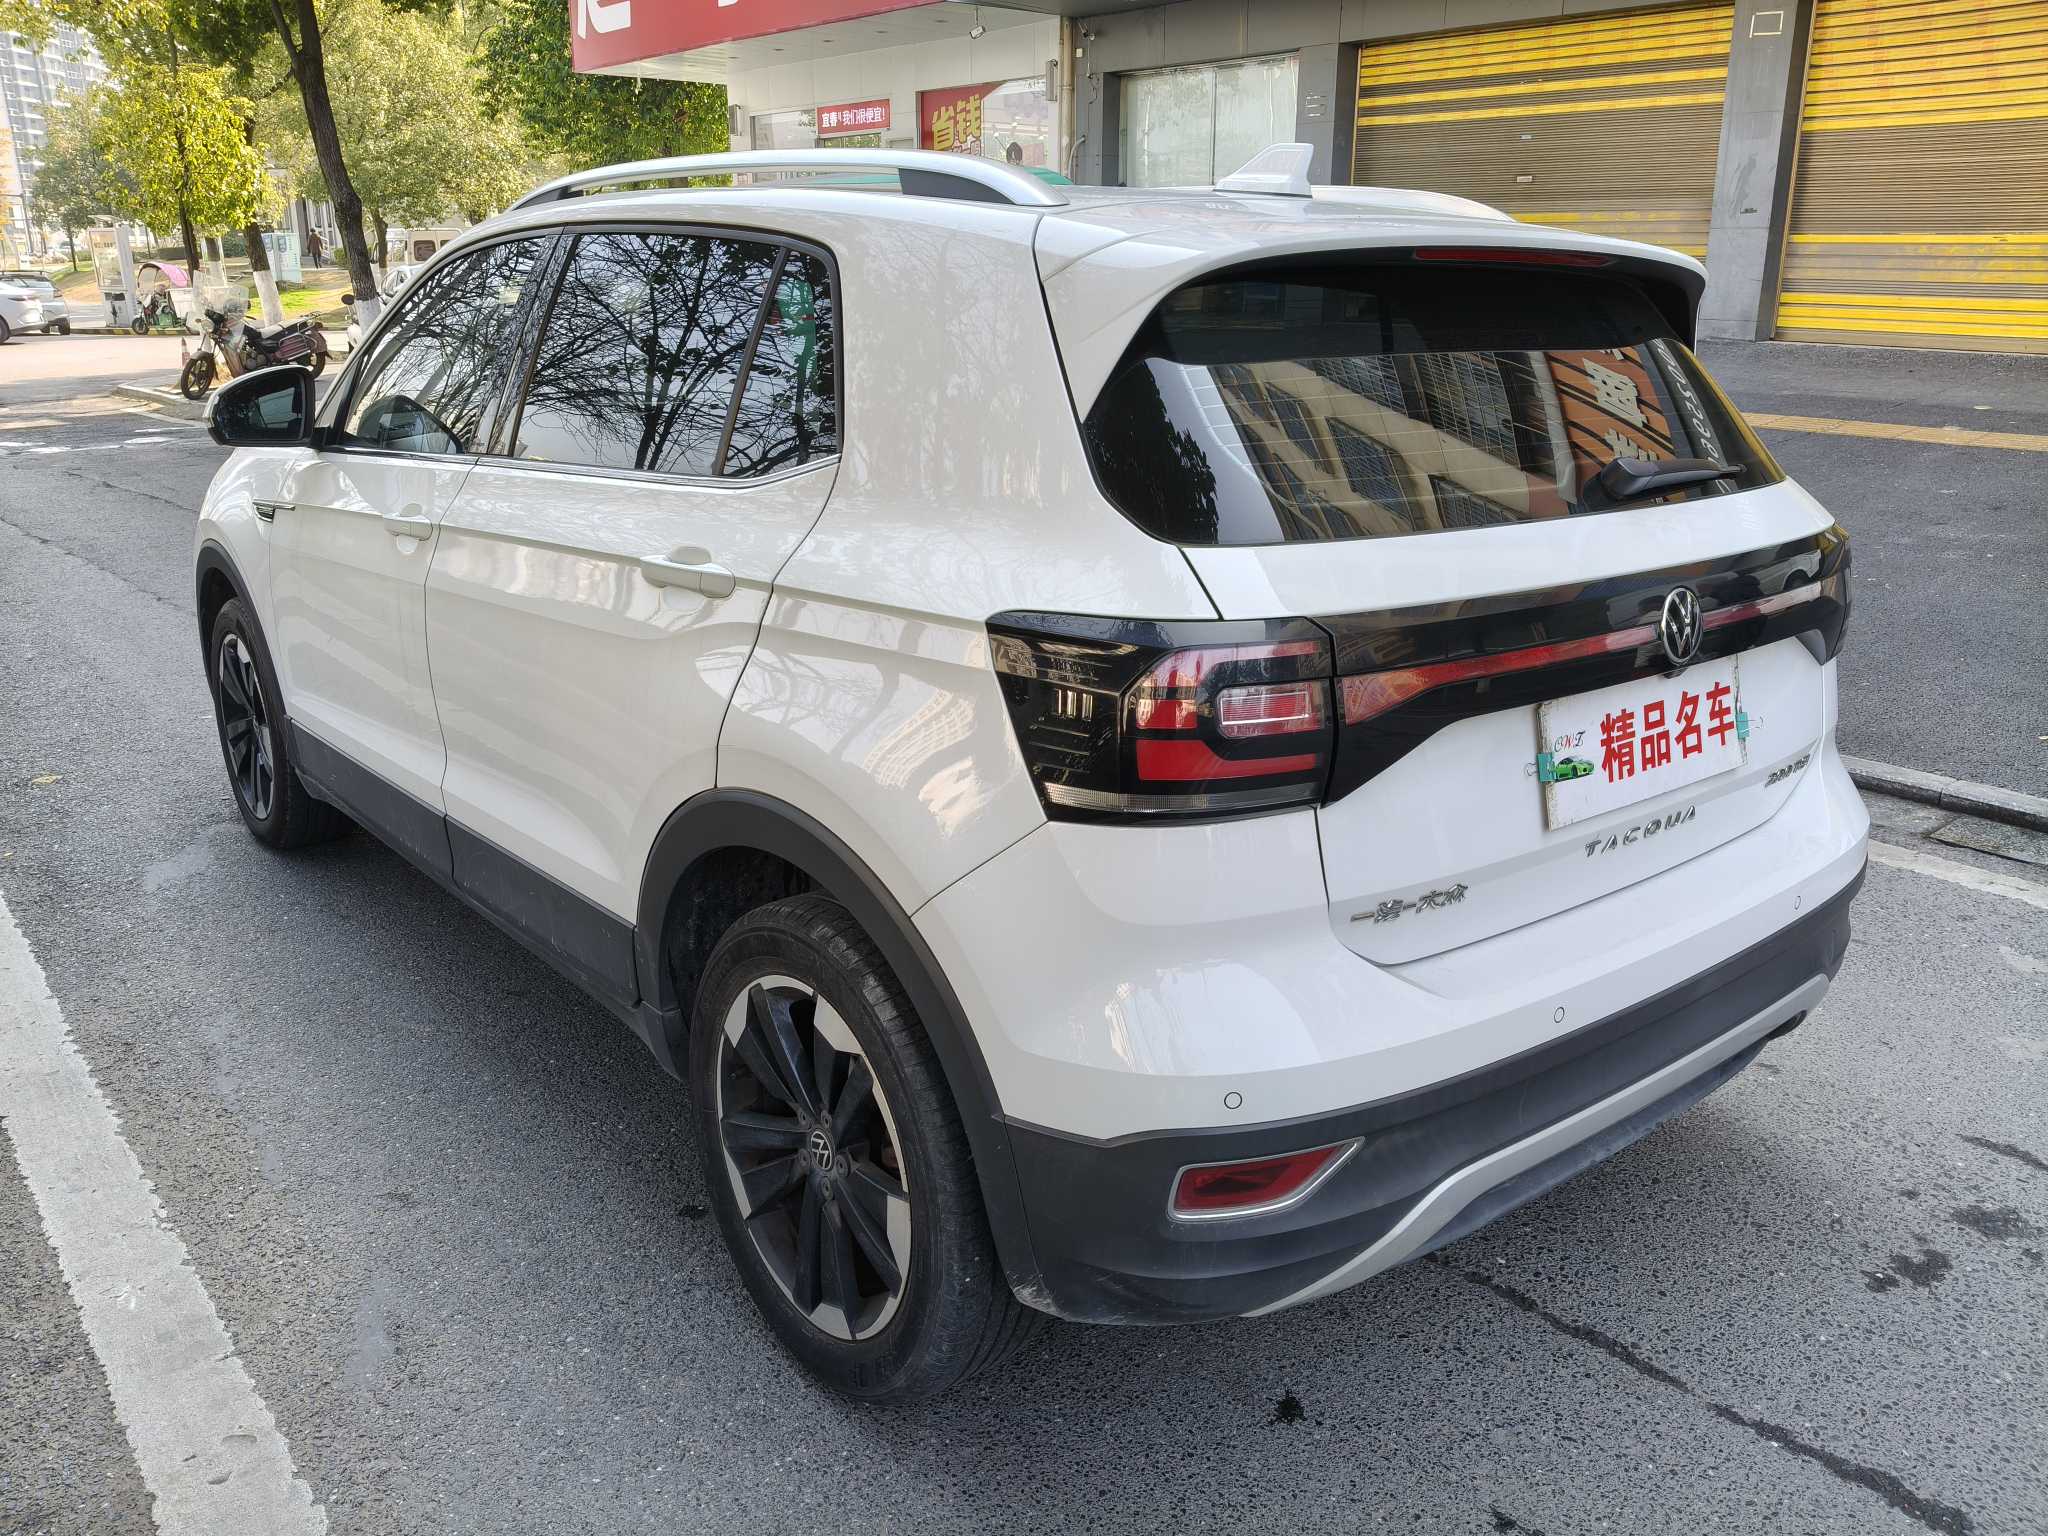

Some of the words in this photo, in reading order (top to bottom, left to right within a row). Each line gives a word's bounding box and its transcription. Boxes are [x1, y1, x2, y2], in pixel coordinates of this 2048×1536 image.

[1599, 681, 1736, 784] 精品名车
[1584, 804, 1697, 858] TACQUA
